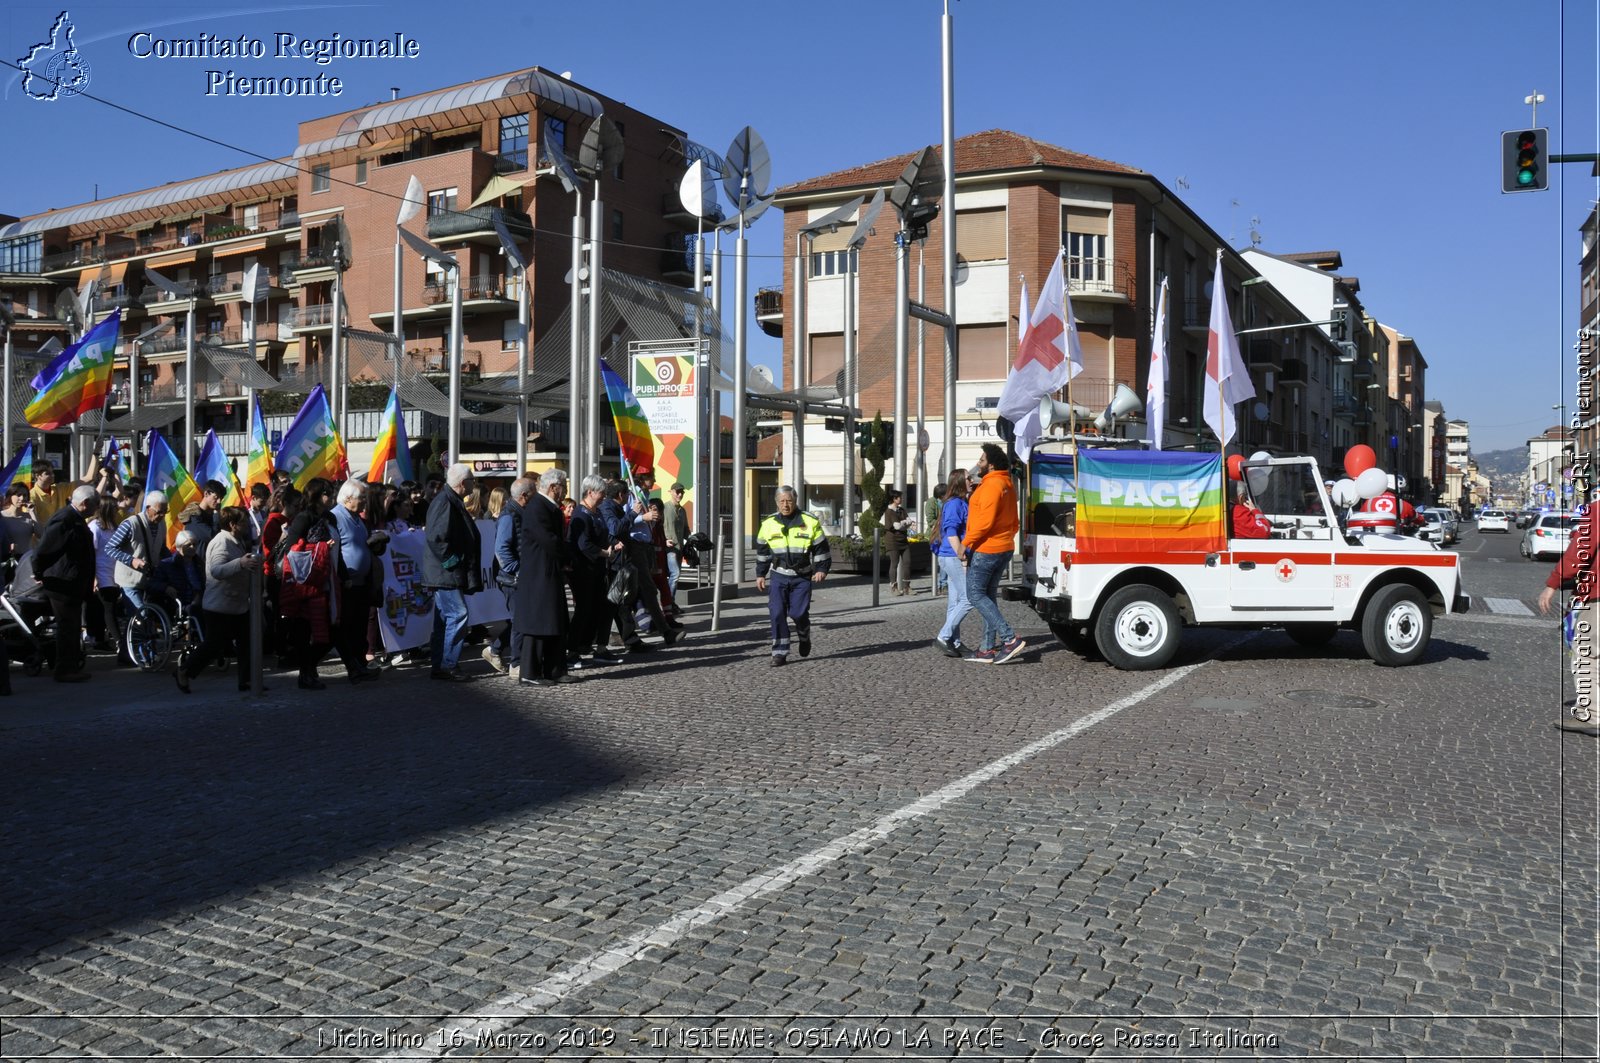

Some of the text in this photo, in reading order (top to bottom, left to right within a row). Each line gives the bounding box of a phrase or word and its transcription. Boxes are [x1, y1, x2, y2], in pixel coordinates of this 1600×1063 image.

[635, 383, 694, 394] PUBLIPROGET
[955, 424, 999, 438] OTTIC
[1099, 478, 1200, 508] PACE
